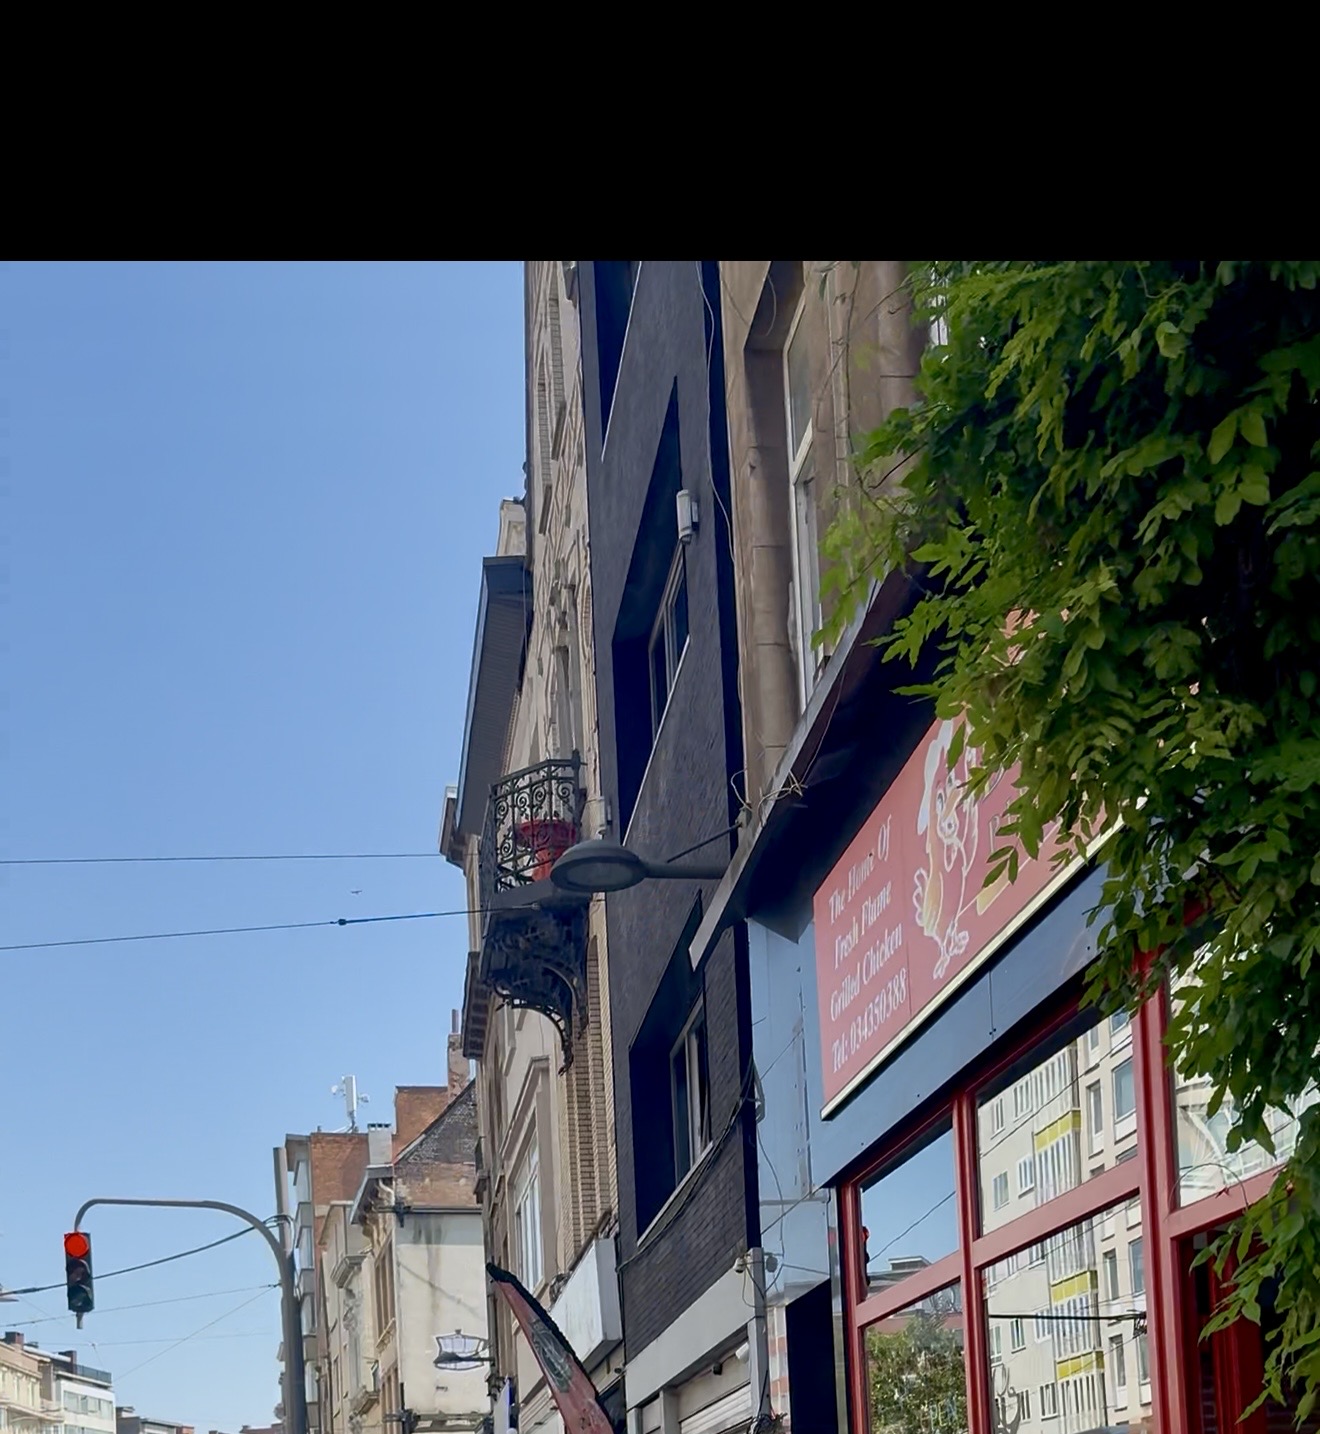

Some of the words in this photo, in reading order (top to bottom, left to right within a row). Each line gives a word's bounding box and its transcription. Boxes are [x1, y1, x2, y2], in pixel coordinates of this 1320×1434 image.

[829, 888, 846, 925] The
[848, 848, 875, 902] Home
[878, 814, 892, 861] Of
[830, 961, 860, 1021] Grilled
[862, 922, 902, 985] Chicken
[834, 915, 859, 970] Fresh
[862, 880, 892, 936] Flame
